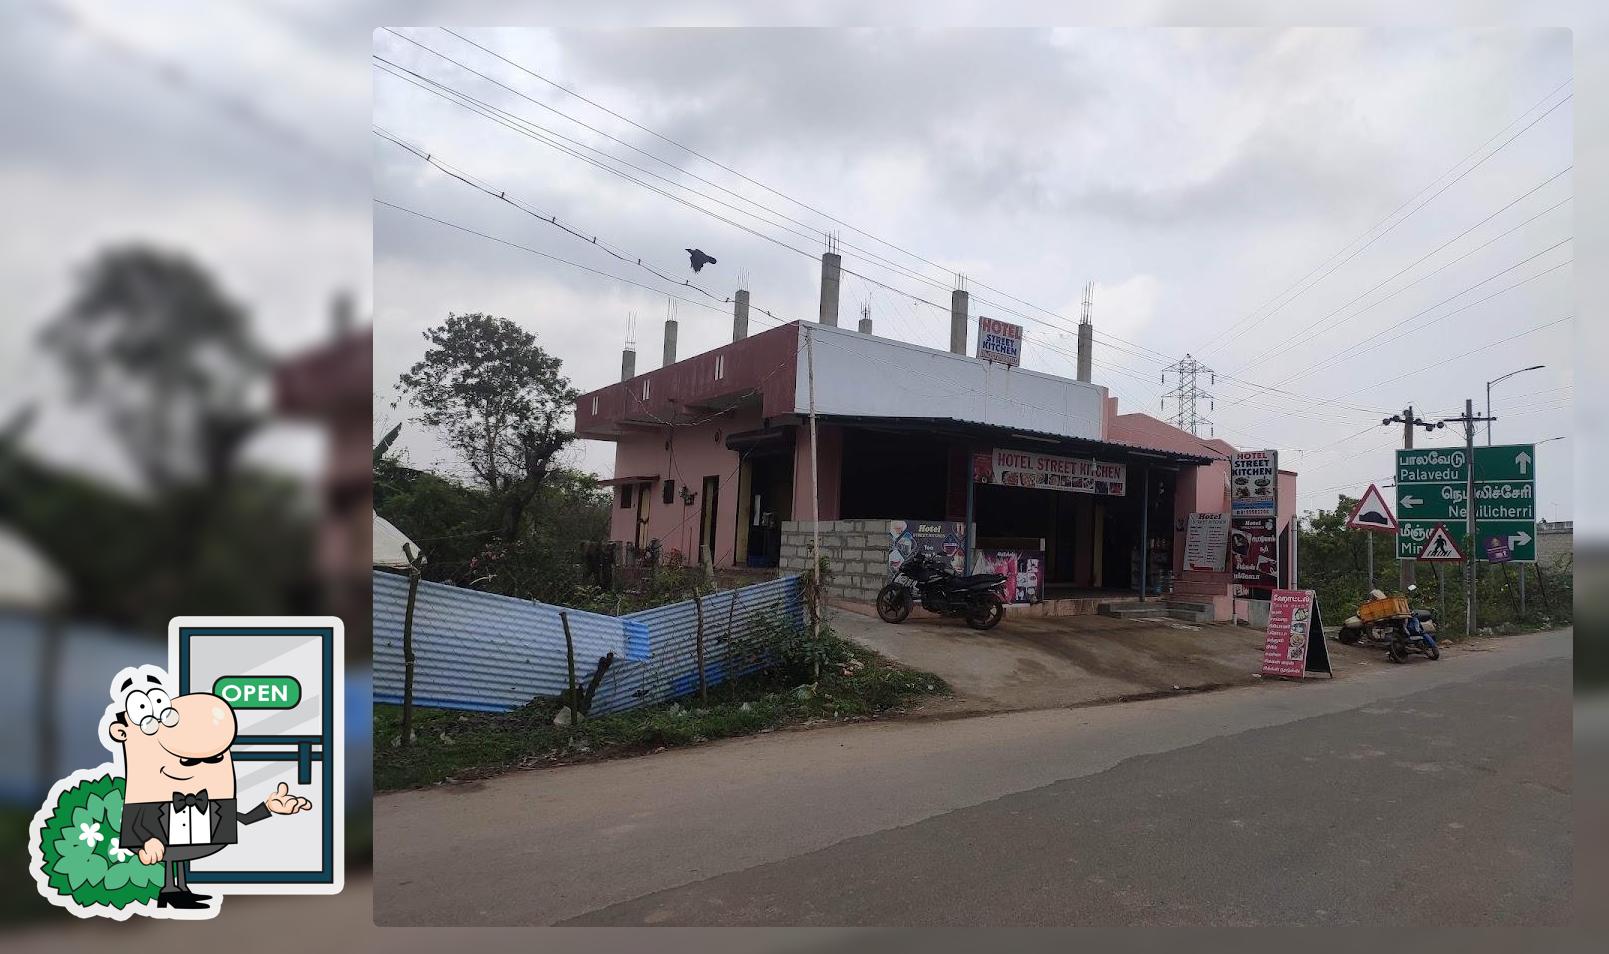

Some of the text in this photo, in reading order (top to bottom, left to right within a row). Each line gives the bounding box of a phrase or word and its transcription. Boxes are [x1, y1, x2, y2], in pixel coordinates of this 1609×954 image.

[981, 317, 1020, 341] HOTEL
[986, 333, 1015, 348] STREET
[982, 340, 1017, 356] KITCHEN
[1237, 452, 1267, 460] HOTEL
[1400, 451, 1465, 468] பாலவேடு
[998, 452, 1032, 470] HOTEL
[1037, 457, 1076, 475] STREET
[1235, 460, 1270, 468] STREET
[1232, 468, 1272, 476] KITCHEN
[1400, 468, 1459, 480] Palavedu
[1448, 505, 1532, 518] Neilicherri
[919, 524, 942, 533] Hotel
